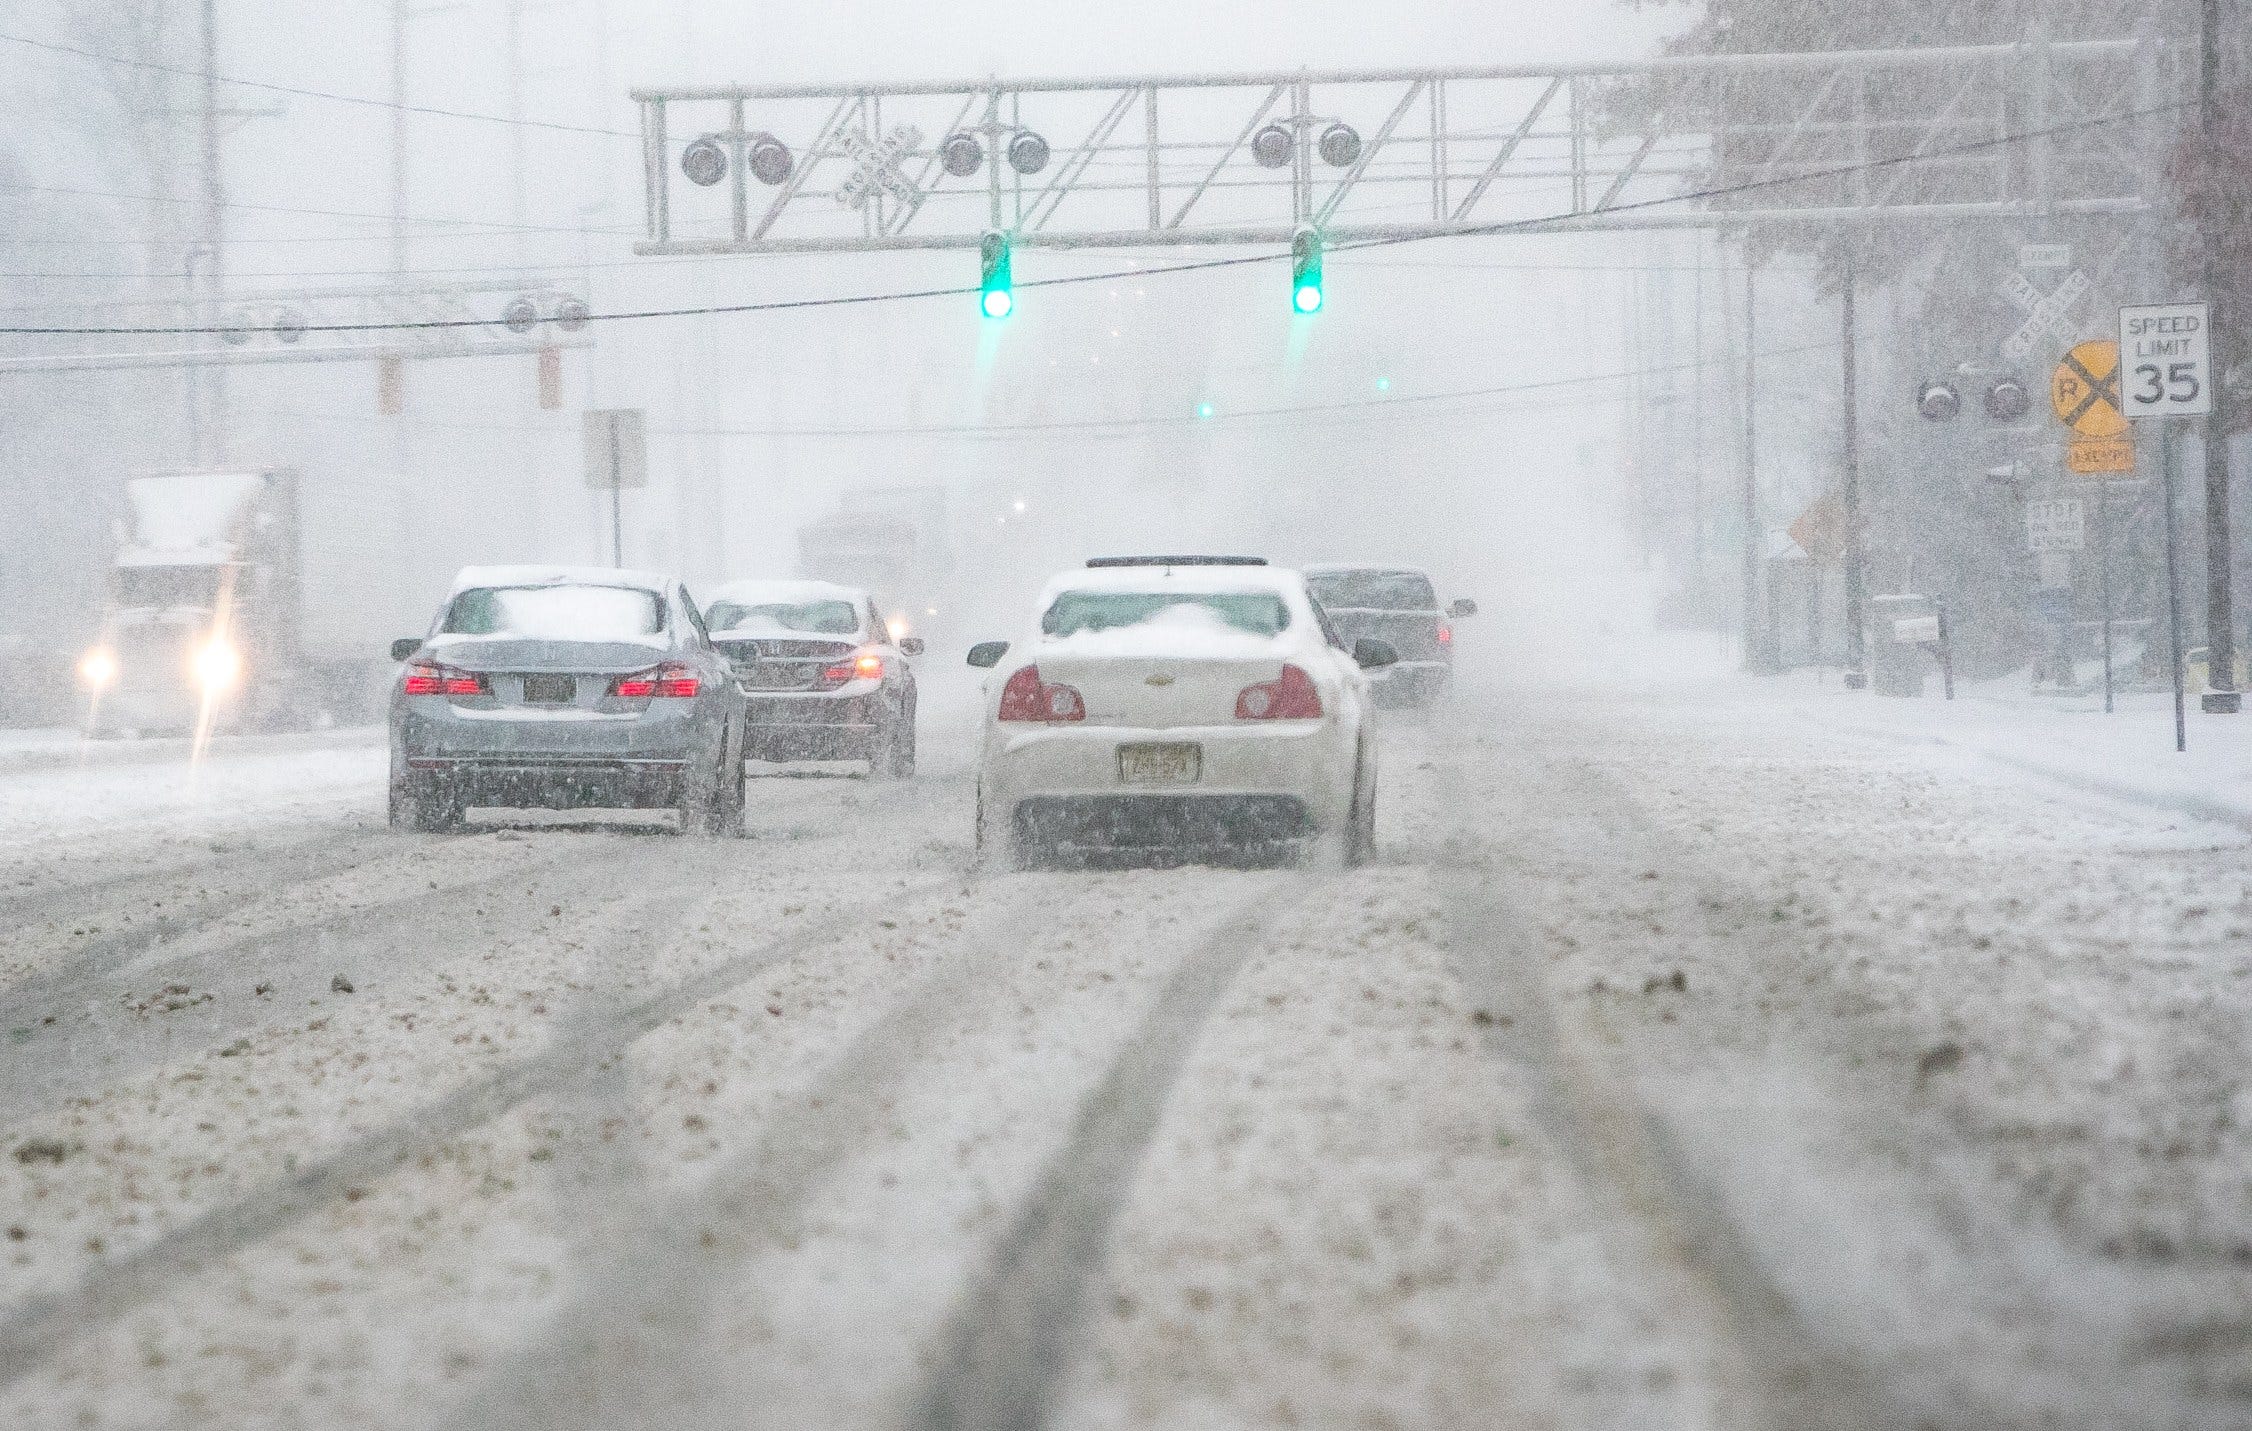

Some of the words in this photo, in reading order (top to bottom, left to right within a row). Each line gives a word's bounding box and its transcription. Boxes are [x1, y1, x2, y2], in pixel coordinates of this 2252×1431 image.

[2128, 315, 2201, 335] SPEED
[2136, 338, 2192, 358] LIMIT
[2058, 378, 2079, 403] R
[2133, 362, 2201, 404] 35
